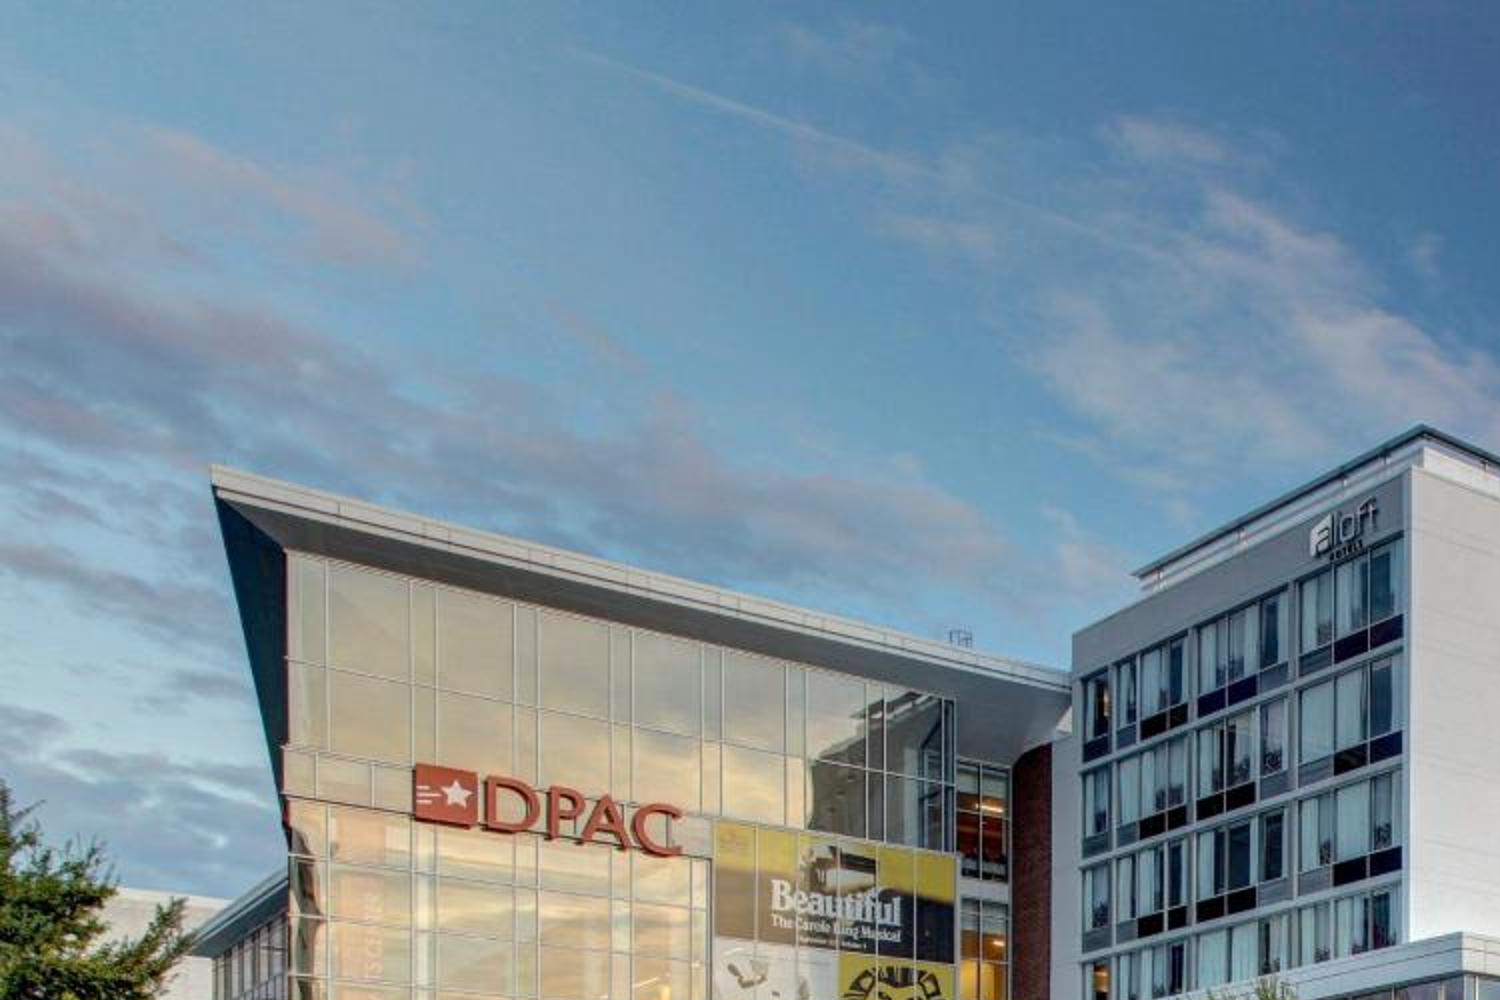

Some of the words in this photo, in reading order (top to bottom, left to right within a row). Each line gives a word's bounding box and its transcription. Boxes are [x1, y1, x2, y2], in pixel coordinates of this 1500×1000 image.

[1310, 495, 1377, 557] aloft
[483, 774, 683, 857] DPAC
[771, 879, 902, 926] Beautiful
[772, 914, 794, 928] The
